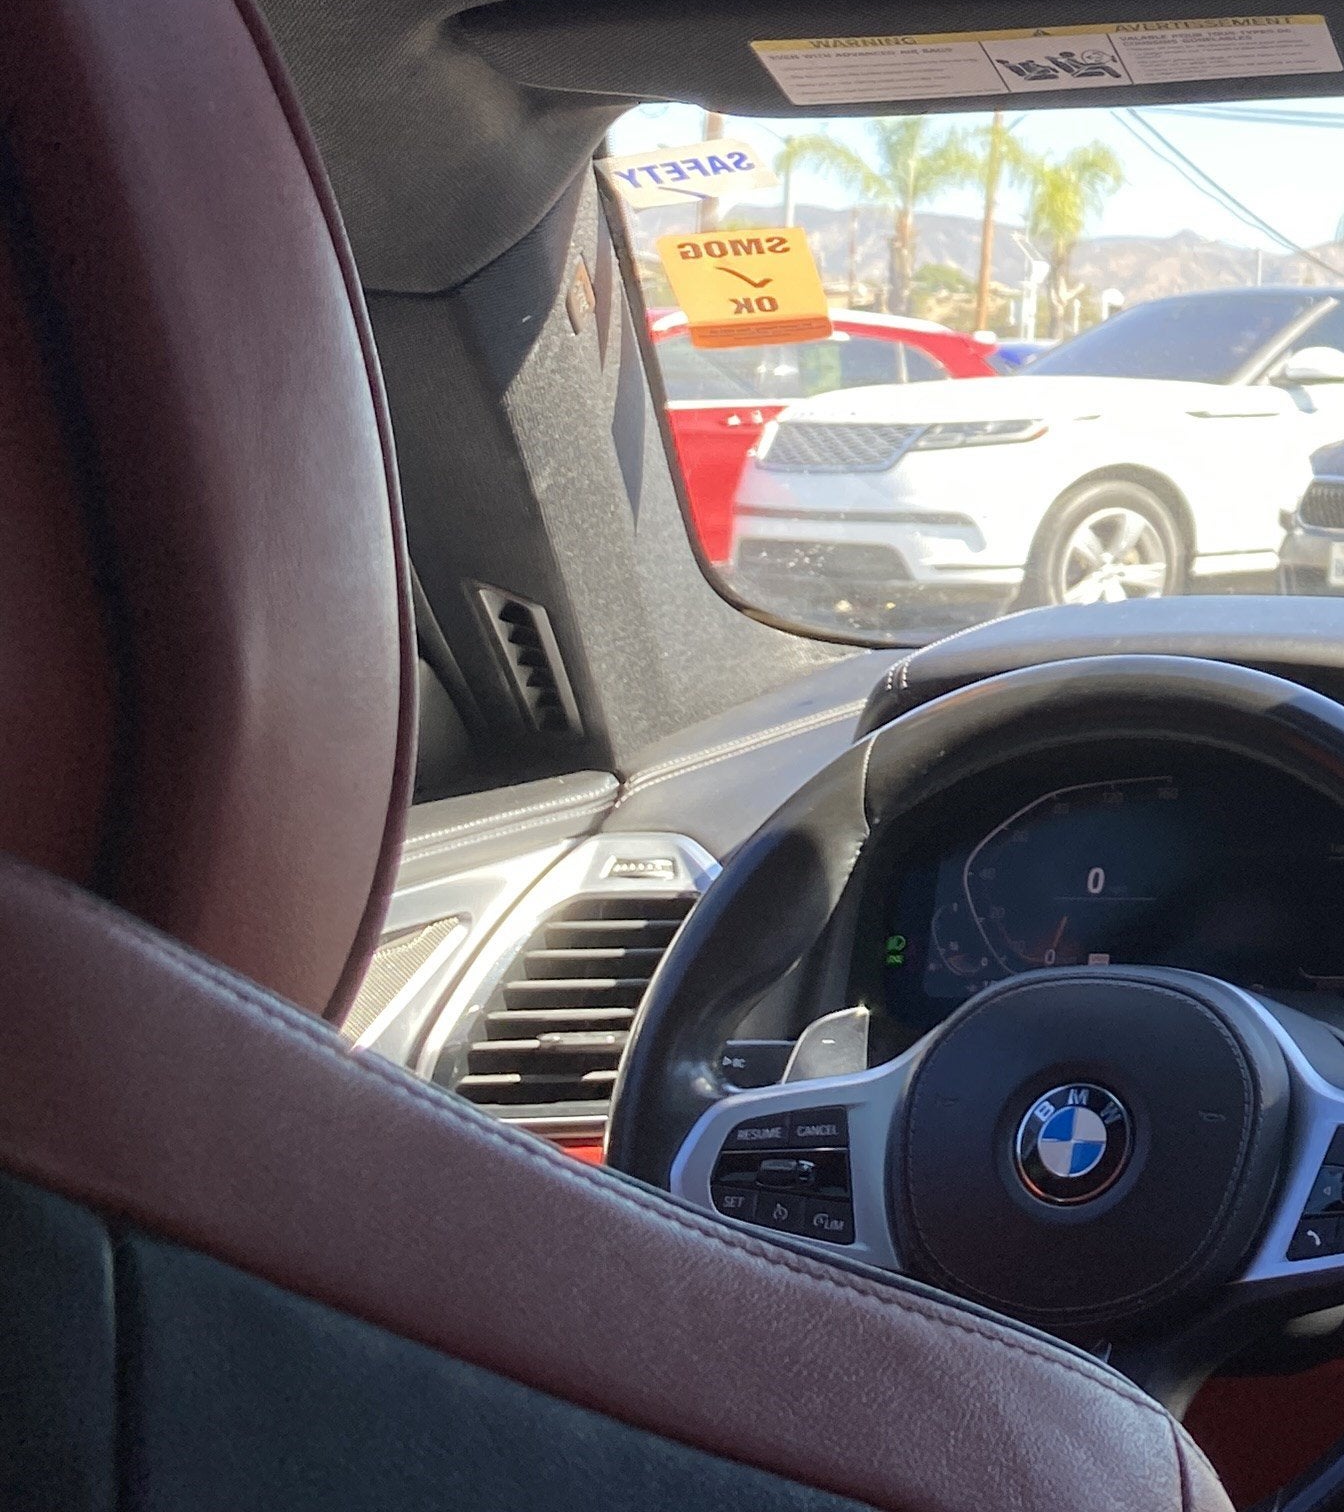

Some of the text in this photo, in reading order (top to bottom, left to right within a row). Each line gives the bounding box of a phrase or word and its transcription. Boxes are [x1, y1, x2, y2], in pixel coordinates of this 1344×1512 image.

[1114, 16, 1293, 33] AVERTISSEMENT
[809, 36, 917, 49] WARNING
[1087, 867, 1105, 894] 0
[1044, 949, 1056, 965] 0
[737, 1127, 782, 1140] RESUME
[797, 1124, 840, 1137] CANCEL
[724, 1196, 744, 1207] SET
